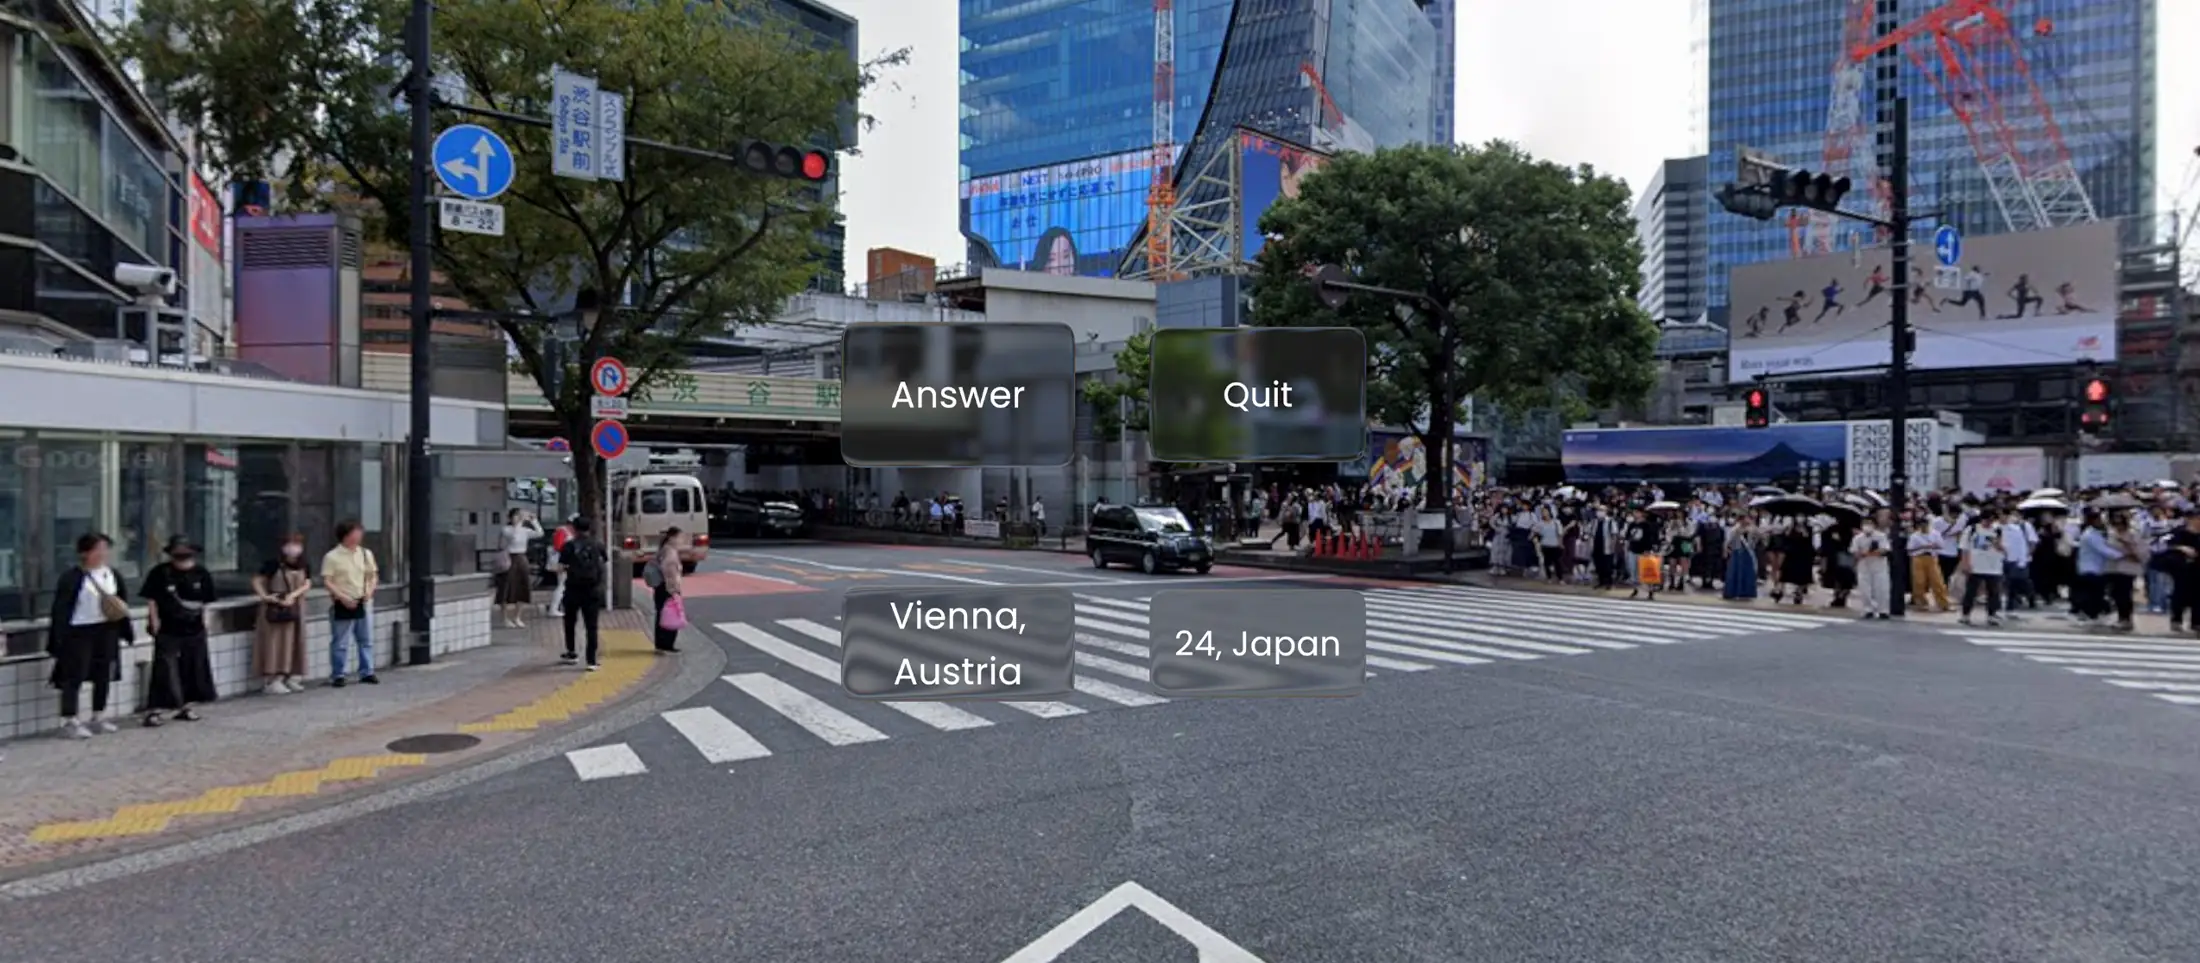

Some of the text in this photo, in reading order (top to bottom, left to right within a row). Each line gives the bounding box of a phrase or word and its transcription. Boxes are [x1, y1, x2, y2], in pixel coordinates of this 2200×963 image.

[559, 94, 571, 134] Shibuya
[572, 84, 591, 171] 渋谷駅前
[673, 374, 840, 408] 渋谷駅
